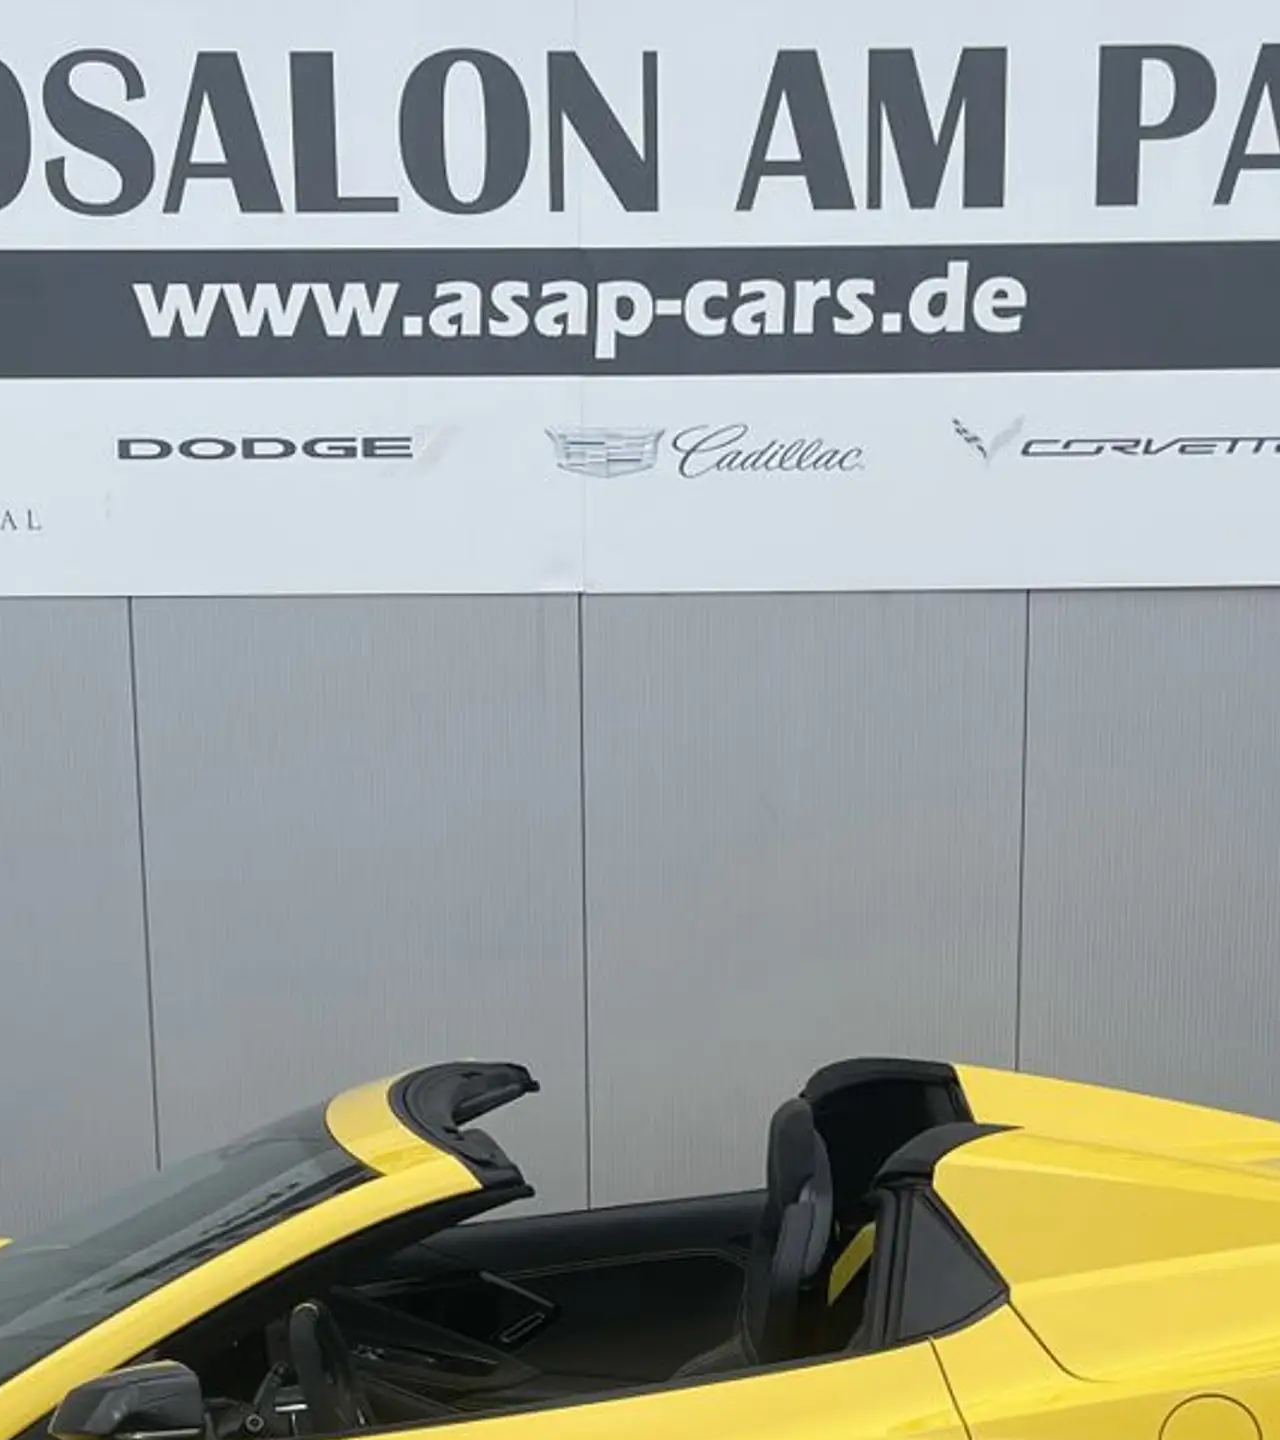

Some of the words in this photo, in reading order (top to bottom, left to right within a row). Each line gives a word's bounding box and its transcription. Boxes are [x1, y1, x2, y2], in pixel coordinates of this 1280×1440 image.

[735, 46, 1008, 212] AM
[132, 260, 1027, 359] www.asap-cars.de
[117, 436, 414, 461] DODGE
[671, 423, 863, 479] Cadillac
